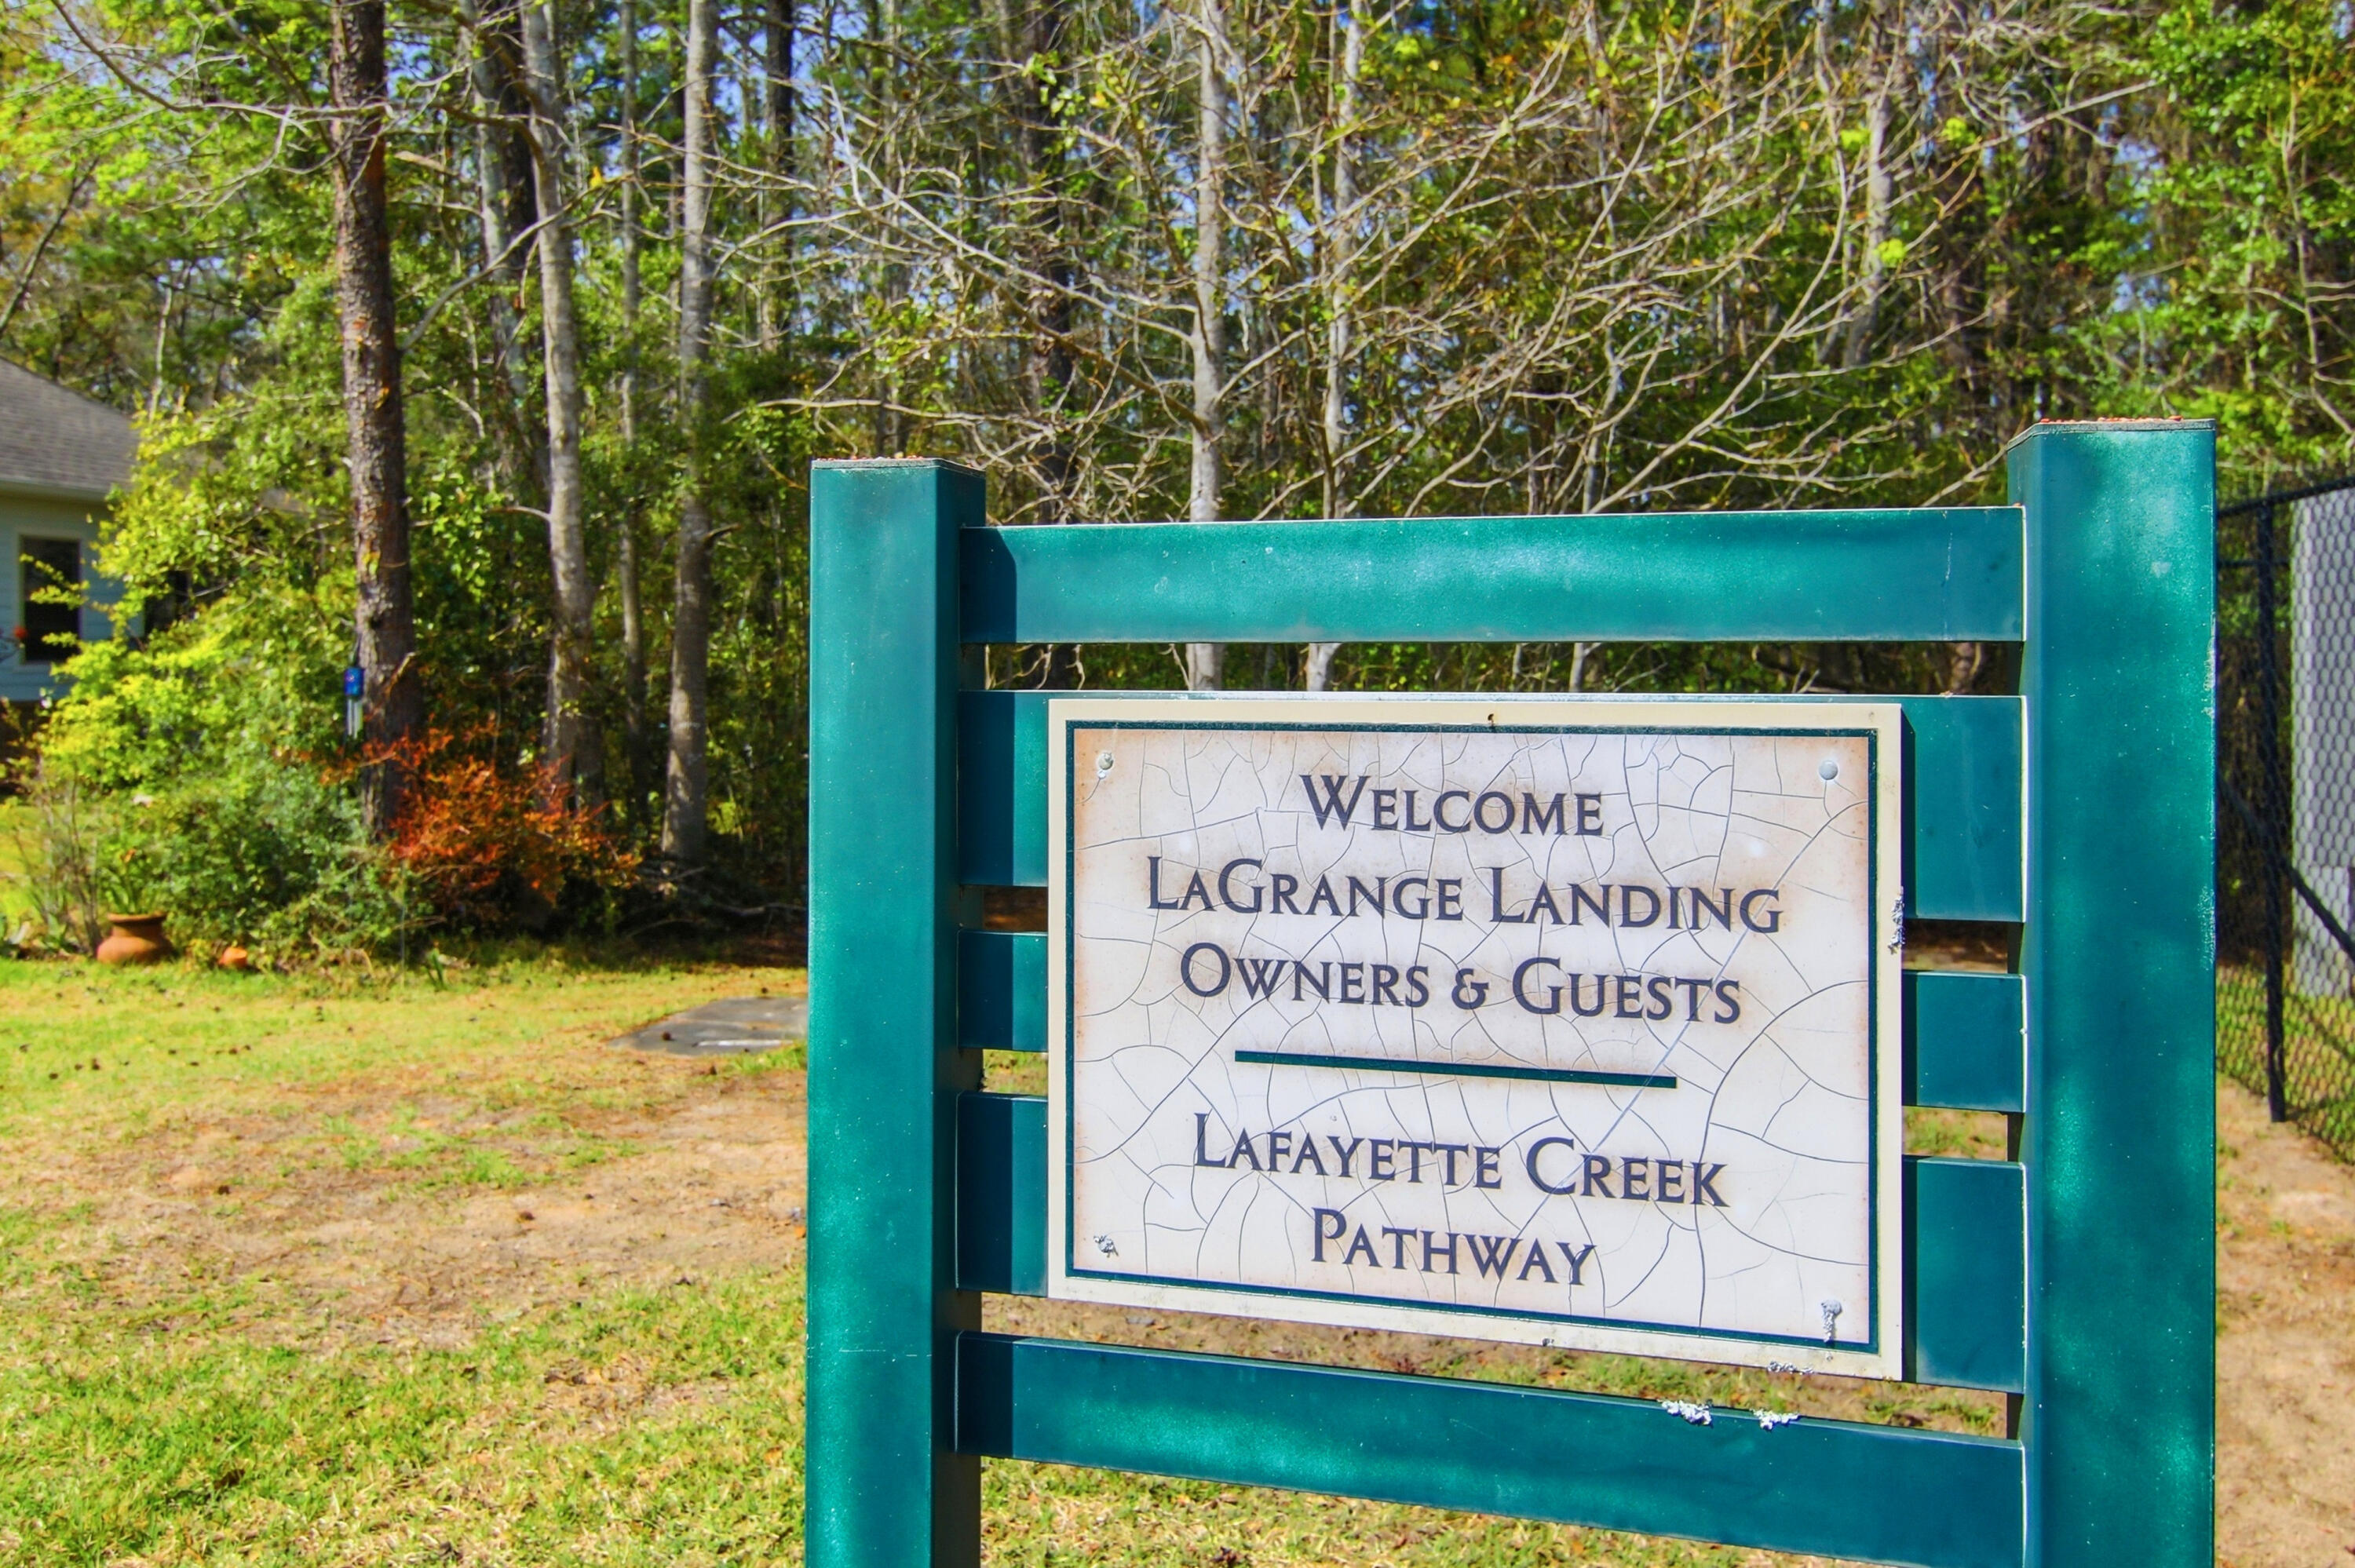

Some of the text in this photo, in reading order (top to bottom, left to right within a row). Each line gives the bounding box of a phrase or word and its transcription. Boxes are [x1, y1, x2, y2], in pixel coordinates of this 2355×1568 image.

[1299, 773, 1604, 837] WELCOME
[1147, 856, 1783, 934] LAGRANGE LANDING
[1180, 942, 1742, 1025] OWNERS & GUESTS
[1193, 1112, 1730, 1207] LAFAYETTE CREEK
[1311, 1206, 1596, 1287] PATHWAY
